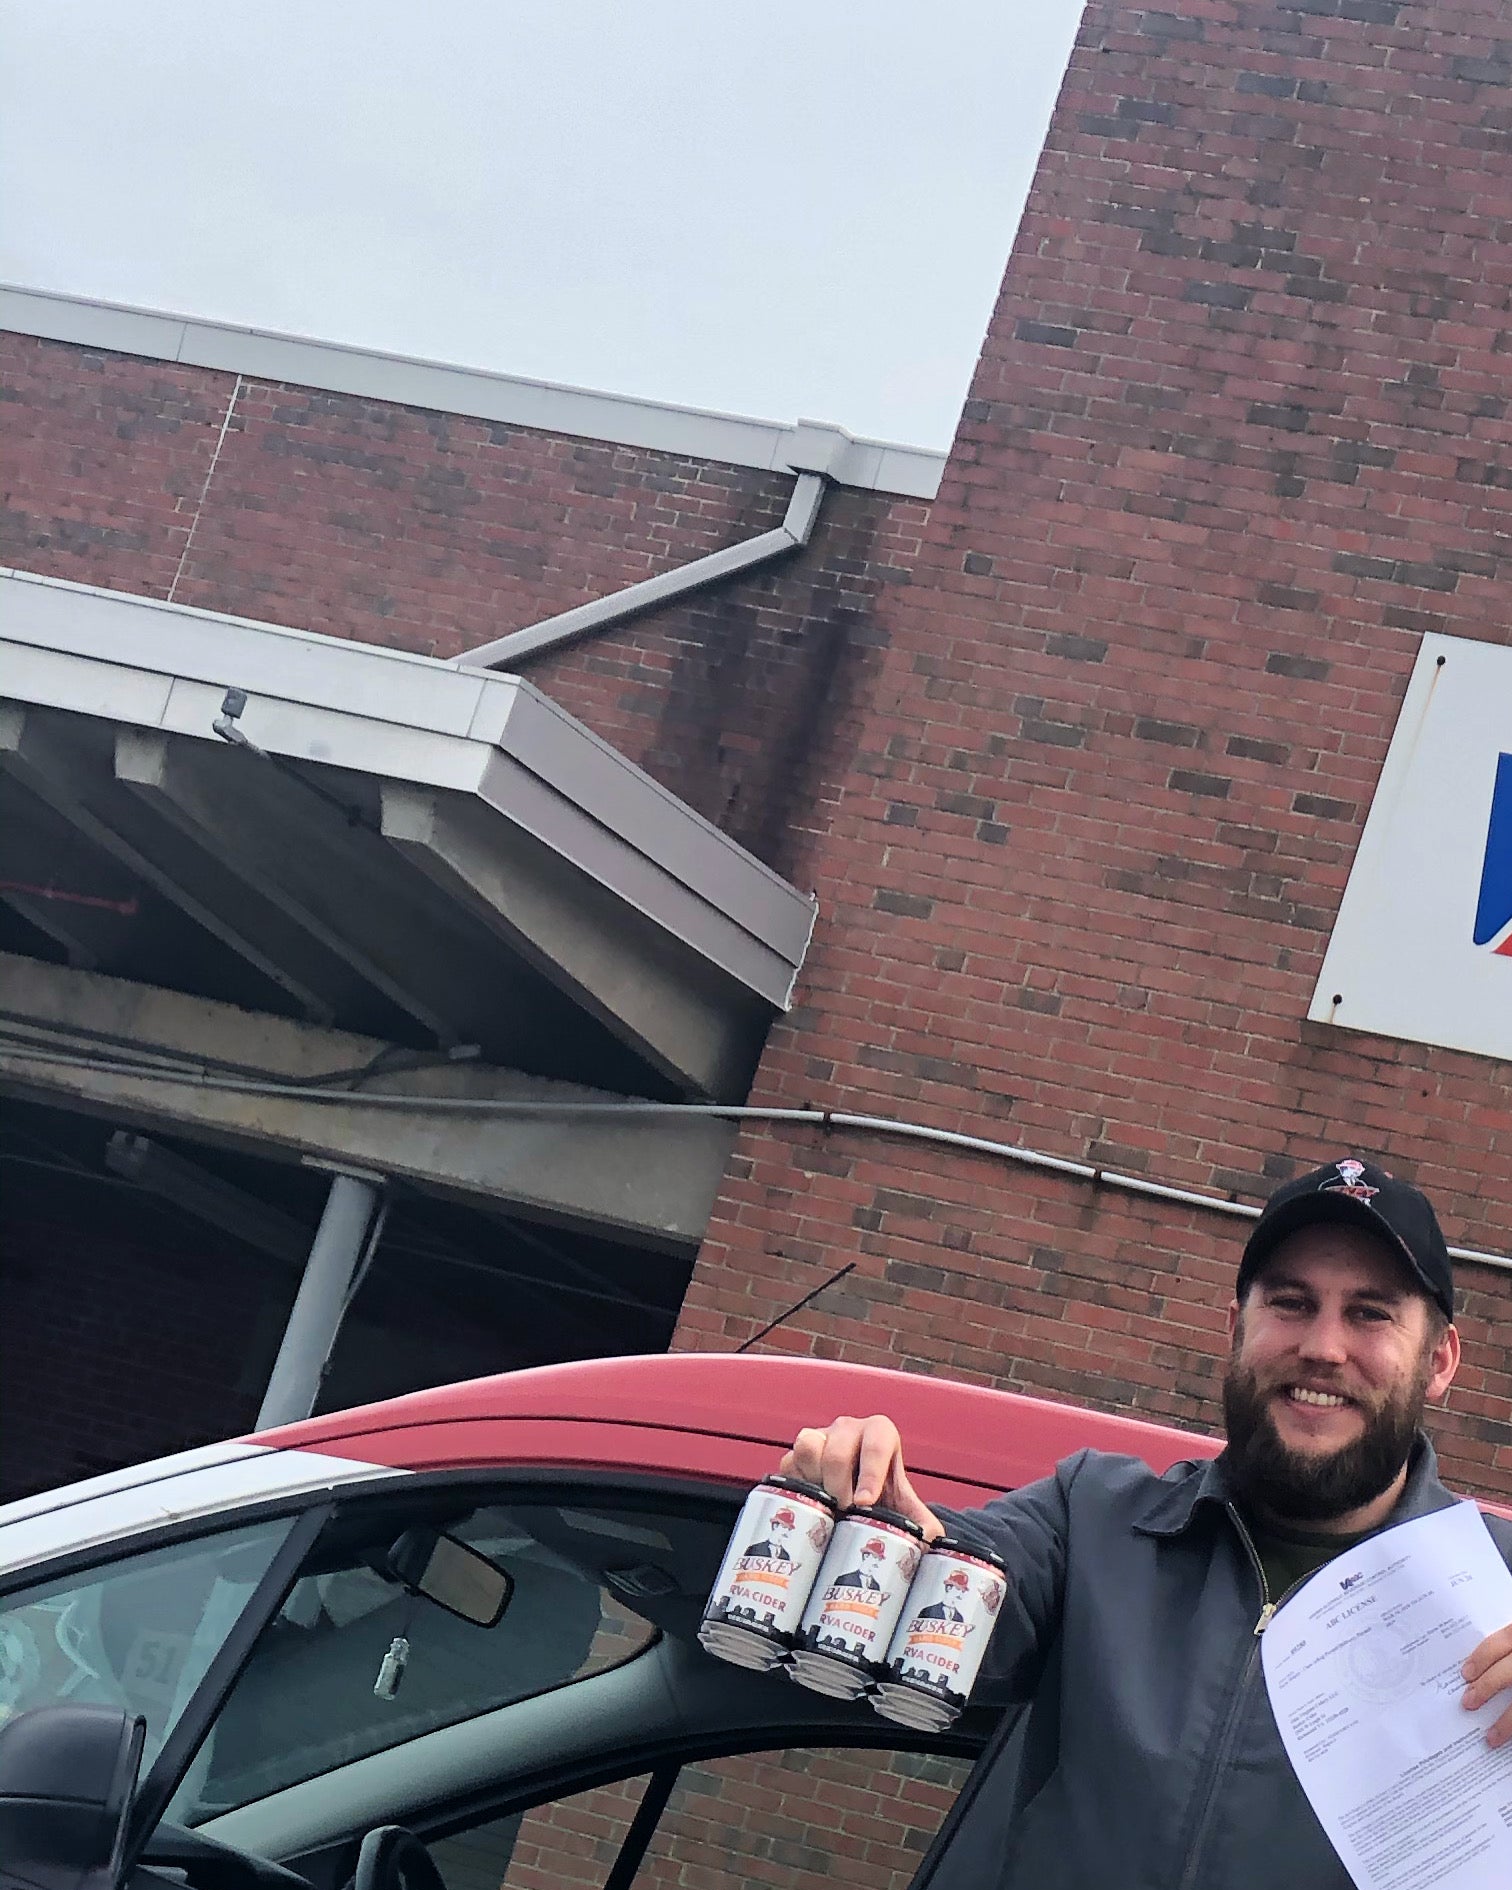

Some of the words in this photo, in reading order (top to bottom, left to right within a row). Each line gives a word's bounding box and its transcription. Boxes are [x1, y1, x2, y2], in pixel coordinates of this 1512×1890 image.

[732, 1558, 802, 1576] BUSKEY
[730, 1584, 750, 1598] RVA
[752, 1591, 787, 1612] CIDER
[822, 1587, 891, 1606] BUSKEY
[820, 1613, 840, 1628] RVA
[843, 1621, 876, 1642] CIDER
[906, 1620, 976, 1638] BUSKEY
[903, 1646, 924, 1660] RVA
[926, 1653, 960, 1674] CIDER
